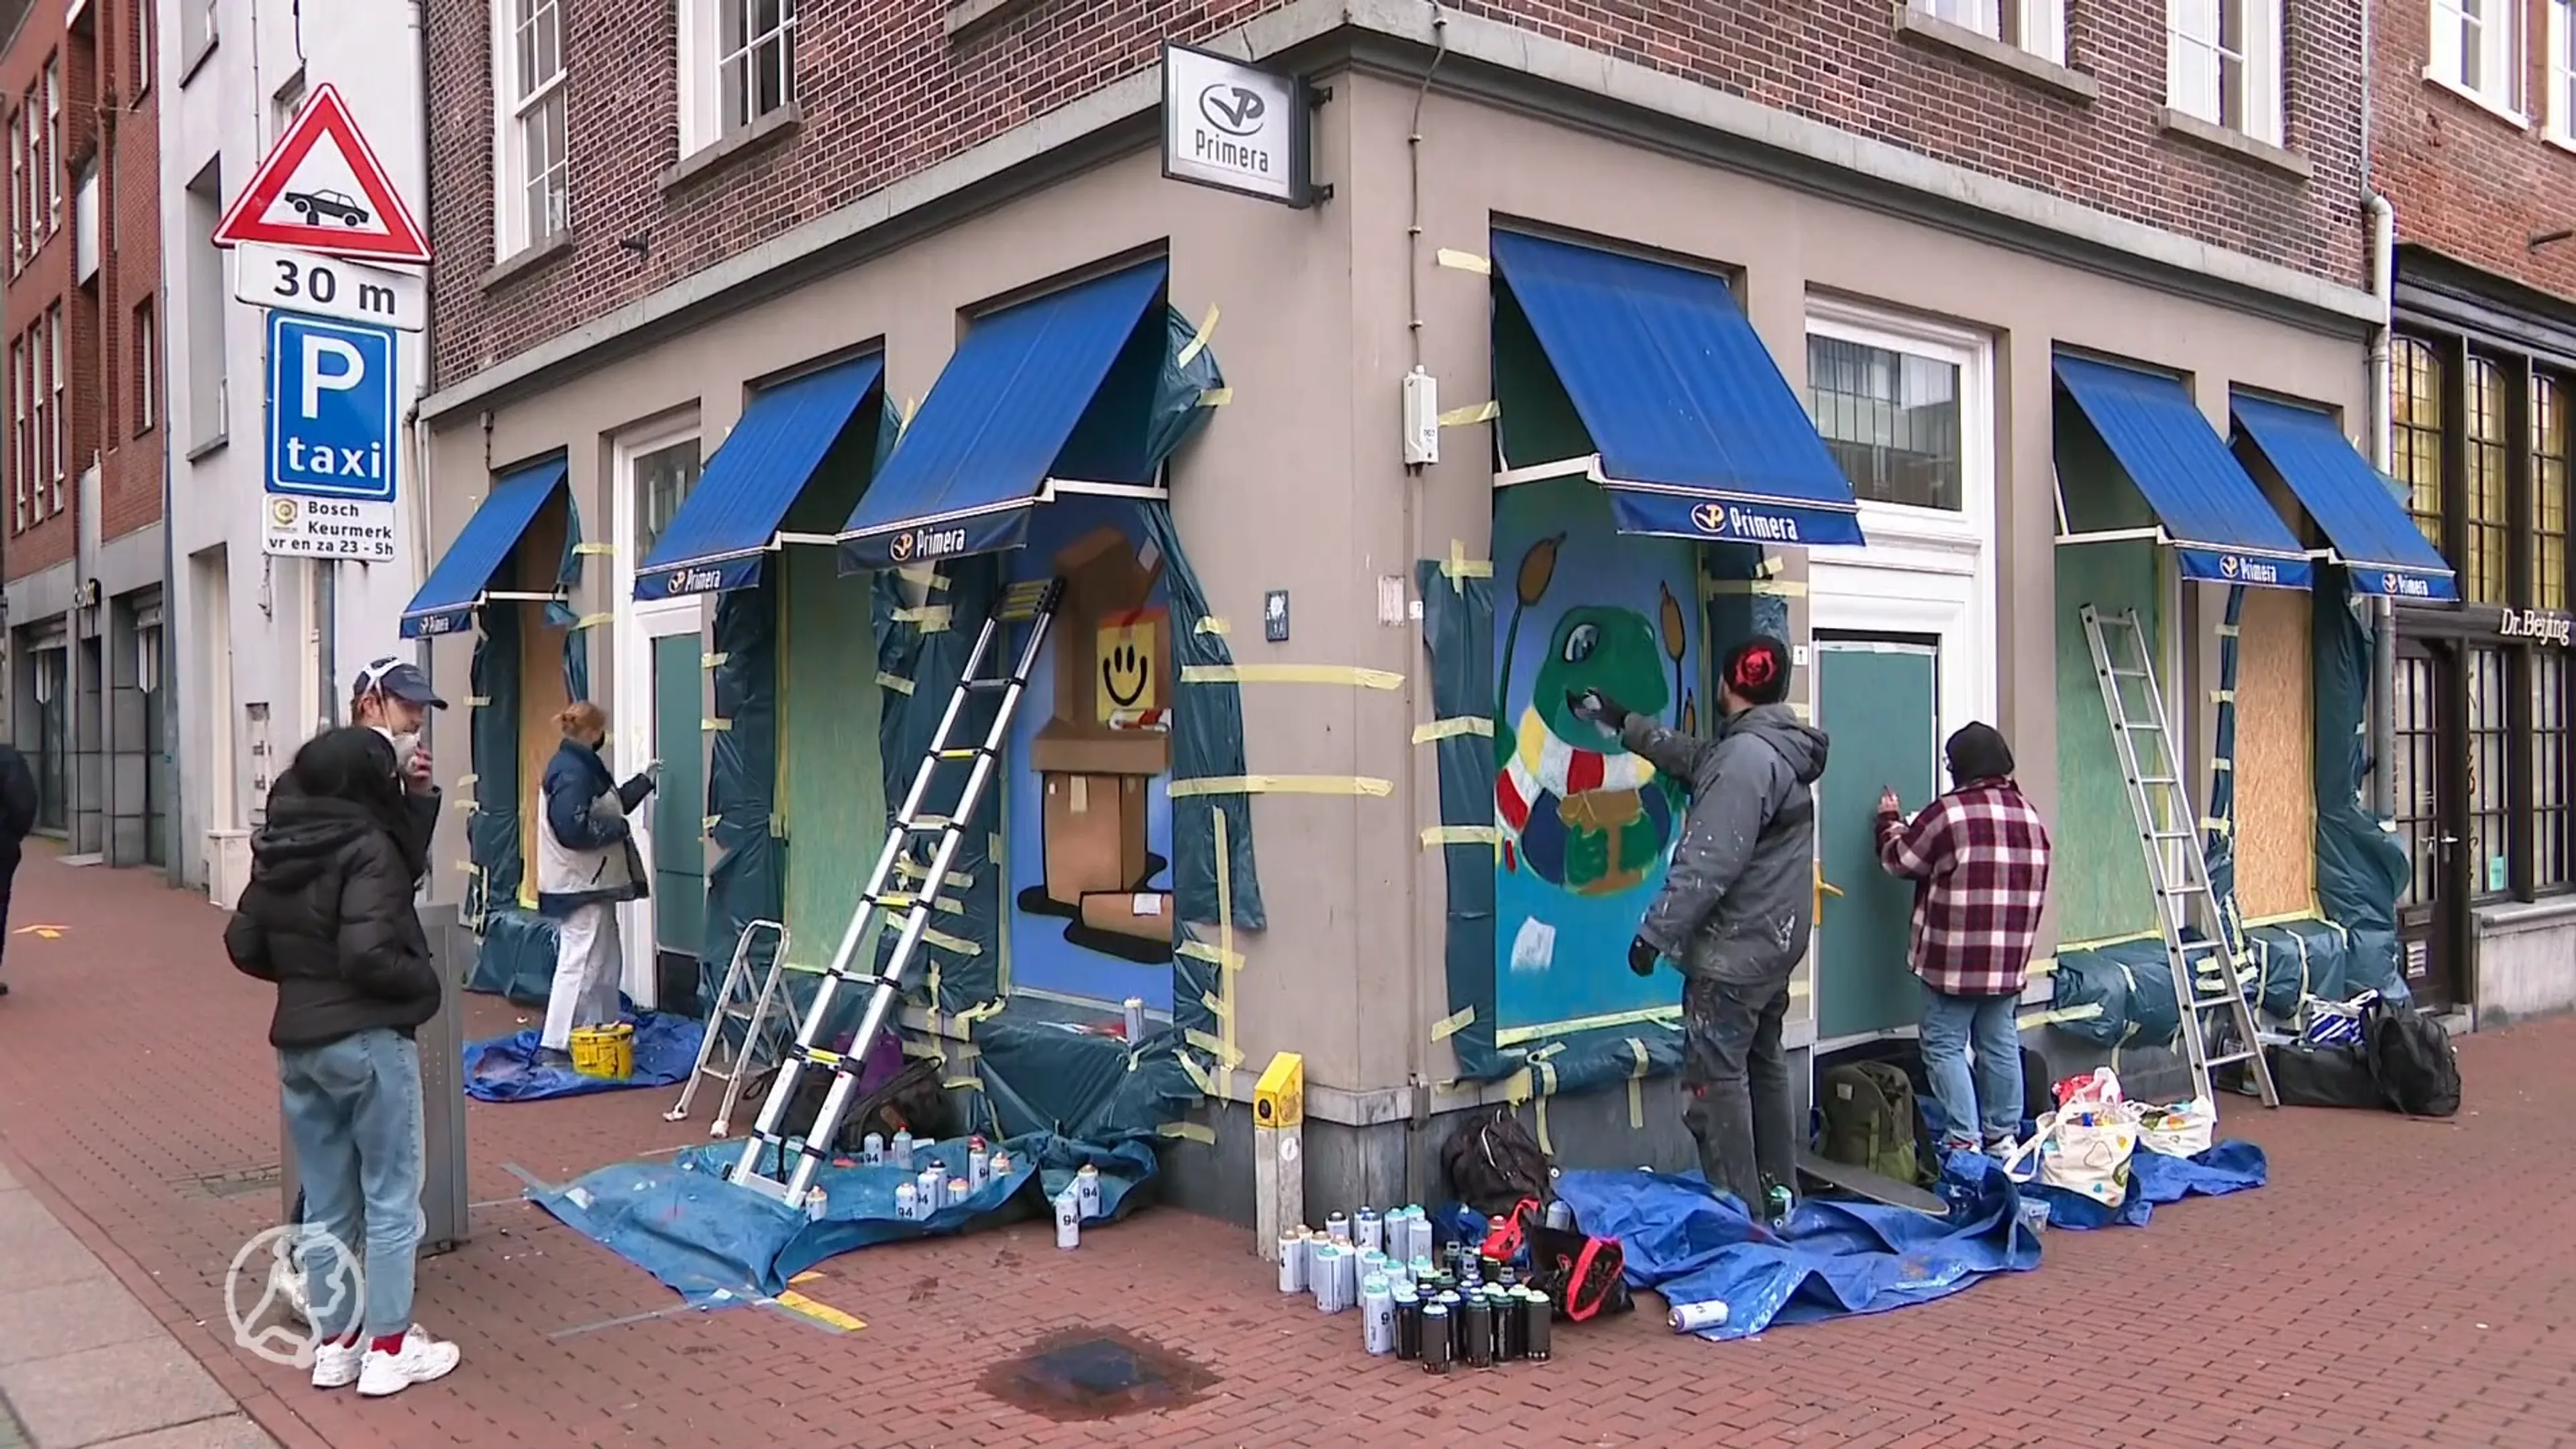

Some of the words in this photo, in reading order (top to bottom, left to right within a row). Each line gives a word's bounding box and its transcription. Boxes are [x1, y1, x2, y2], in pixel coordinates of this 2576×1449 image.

[1195, 128, 1269, 172] Primera
[274, 259, 336, 304] 30
[359, 280, 396, 315] m
[301, 333, 365, 419] P
[286, 436, 382, 478] taxi
[308, 501, 359, 517] Bosch
[308, 521, 392, 539] Keurmerk
[1729, 507, 1799, 541] Primera
[269, 538, 286, 549] vr
[291, 539, 311, 550] en
[317, 541, 334, 551] za
[339, 540, 358, 553] 23
[375, 542, 393, 555] 5h
[916, 527, 966, 558] Primera
[684, 568, 720, 592] Primera
[2240, 557, 2277, 582] Primera
[2397, 574, 2428, 596] Primera
[865, 1153, 879, 1163] 94
[1082, 1187, 1097, 1199] 94
[898, 1207, 912, 1218] 94
